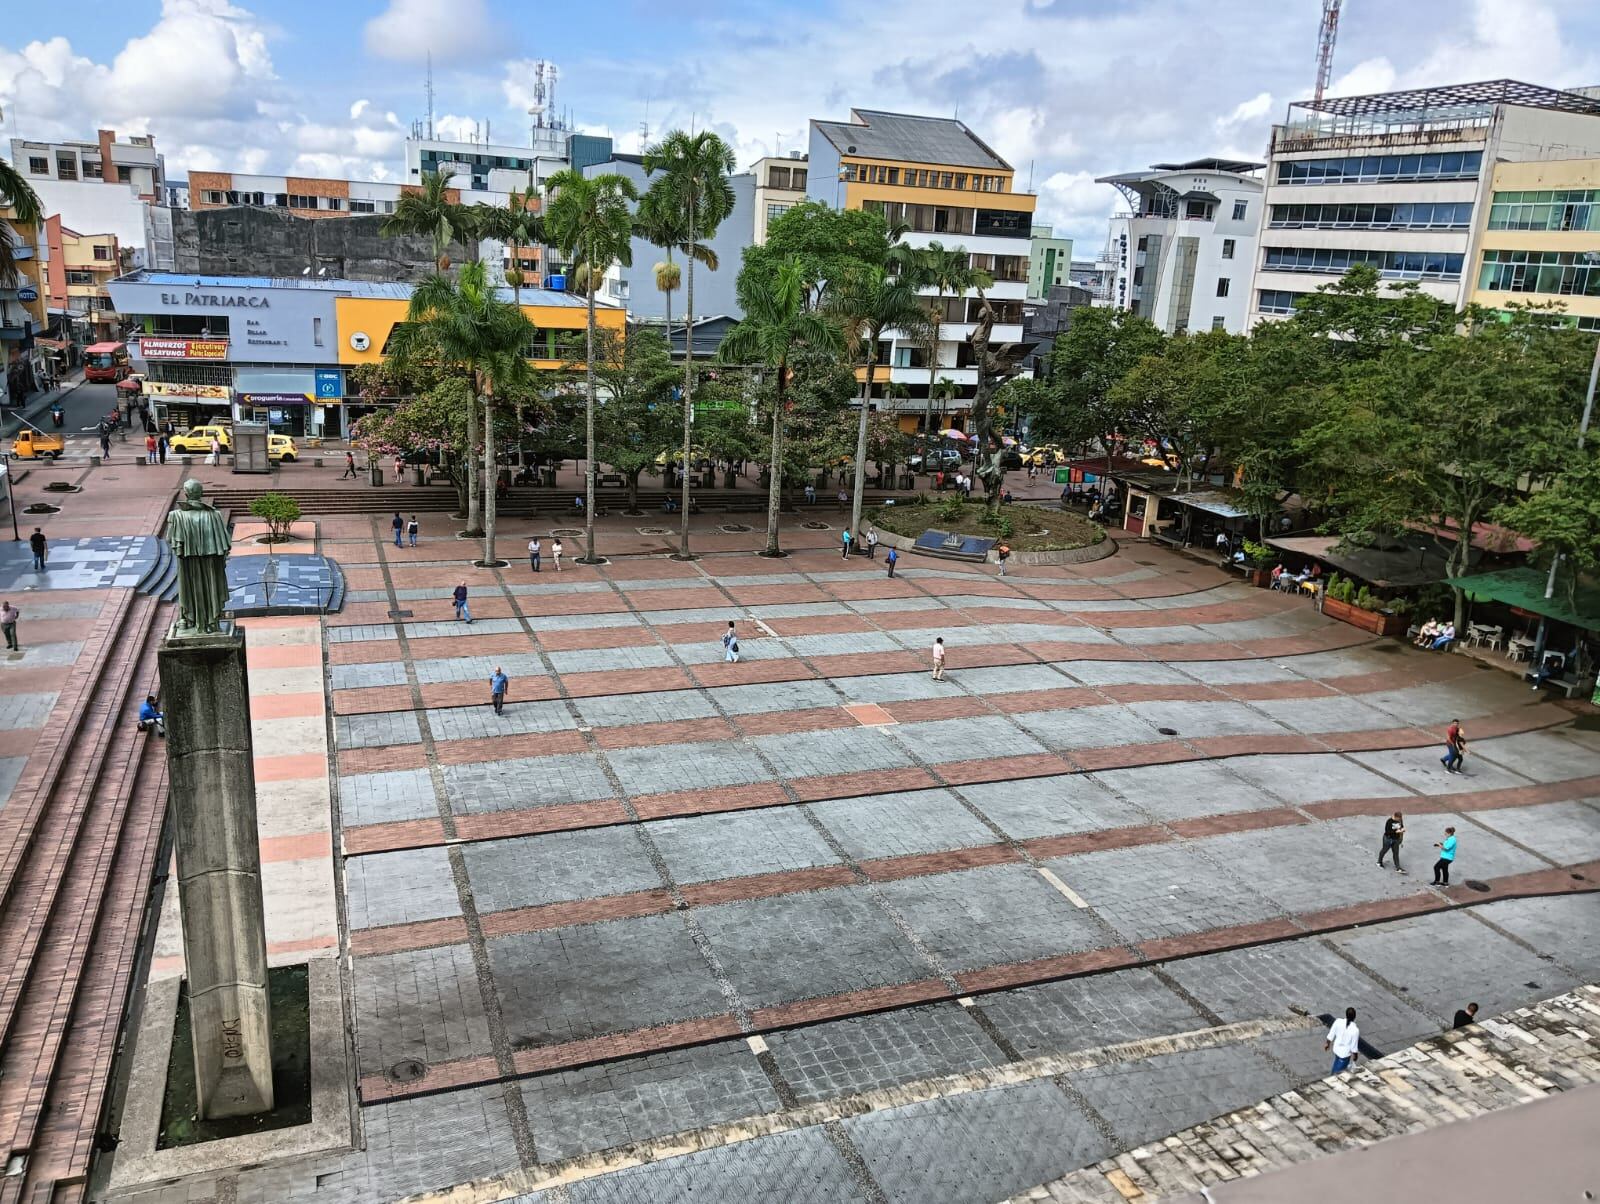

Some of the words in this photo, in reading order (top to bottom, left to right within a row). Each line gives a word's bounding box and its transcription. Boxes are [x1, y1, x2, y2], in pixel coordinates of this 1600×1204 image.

[161, 293, 179, 305] EL
[185, 292, 270, 308] PATRIARCA
[143, 341, 187, 349] ALMUERZOS
[143, 349, 186, 357] DESAYUNOS
